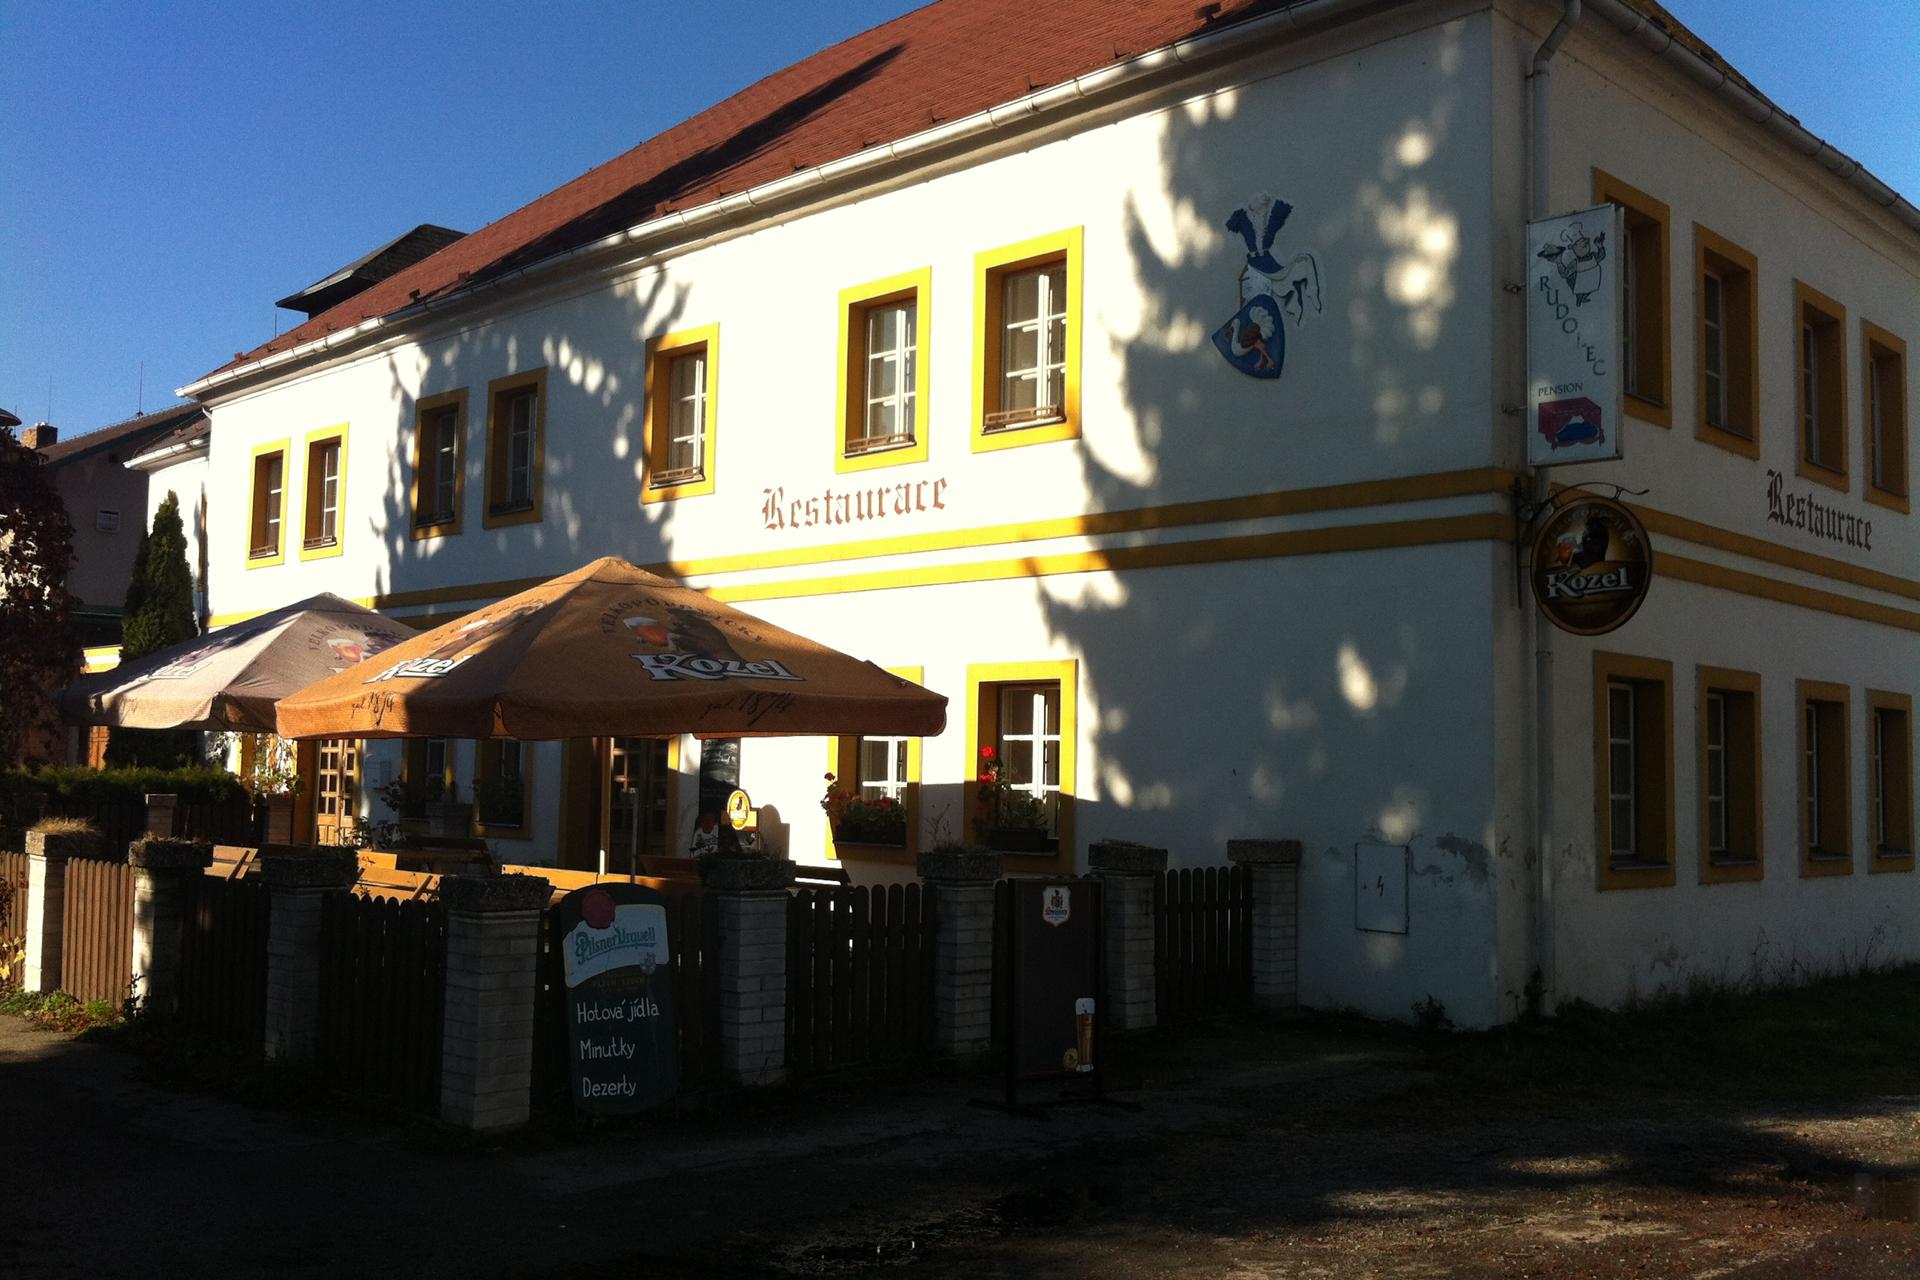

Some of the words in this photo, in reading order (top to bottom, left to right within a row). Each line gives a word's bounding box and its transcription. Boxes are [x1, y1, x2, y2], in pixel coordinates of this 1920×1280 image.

[1538, 382, 1584, 397] PENSION
[762, 477, 948, 531] Restaurace
[1766, 468, 1872, 552] Restaurace
[1546, 567, 1633, 598] Kozel
[362, 654, 478, 685] Kozel
[629, 653, 808, 682] Kozel
[738, 691, 796, 728] 1874
[574, 930, 618, 966] Pilsner
[613, 926, 655, 949] Urquell
[577, 999, 626, 1024] Hotová
[627, 997, 660, 1022] jídla
[580, 1036, 636, 1060] Minutky
[582, 1074, 637, 1098] Dezerty
